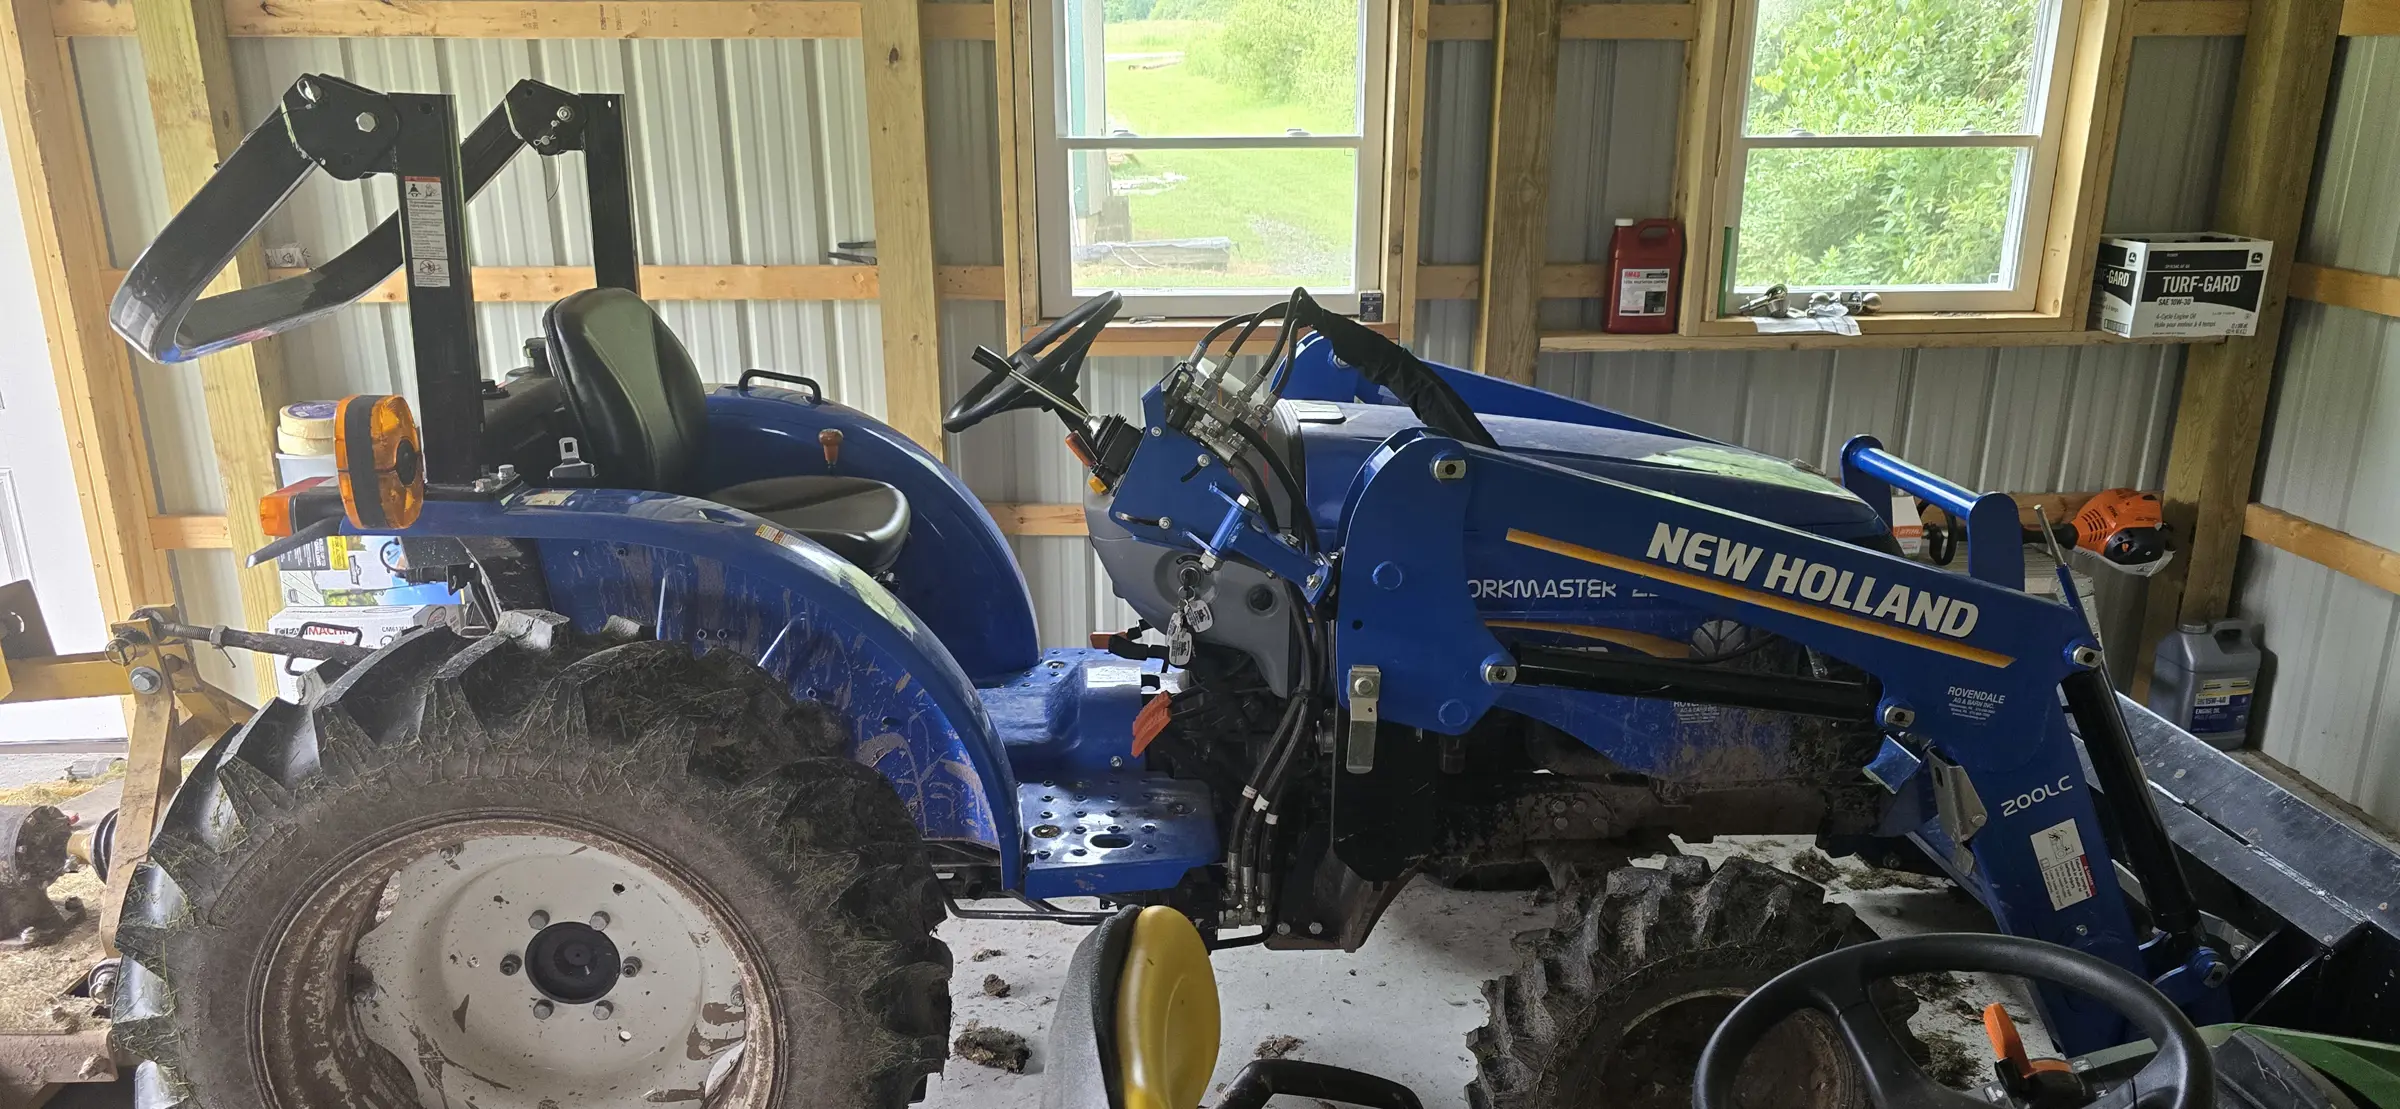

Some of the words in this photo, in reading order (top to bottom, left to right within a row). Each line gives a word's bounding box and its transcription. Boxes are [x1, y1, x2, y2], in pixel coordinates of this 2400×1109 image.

[2162, 275, 2241, 293] TURF-GARD
[1468, 579, 1617, 598] ORKMASTER
[1646, 522, 1763, 582] NEW
[1763, 552, 1979, 638] HOLLAND
[1947, 686, 2005, 704] ROVENDALE
